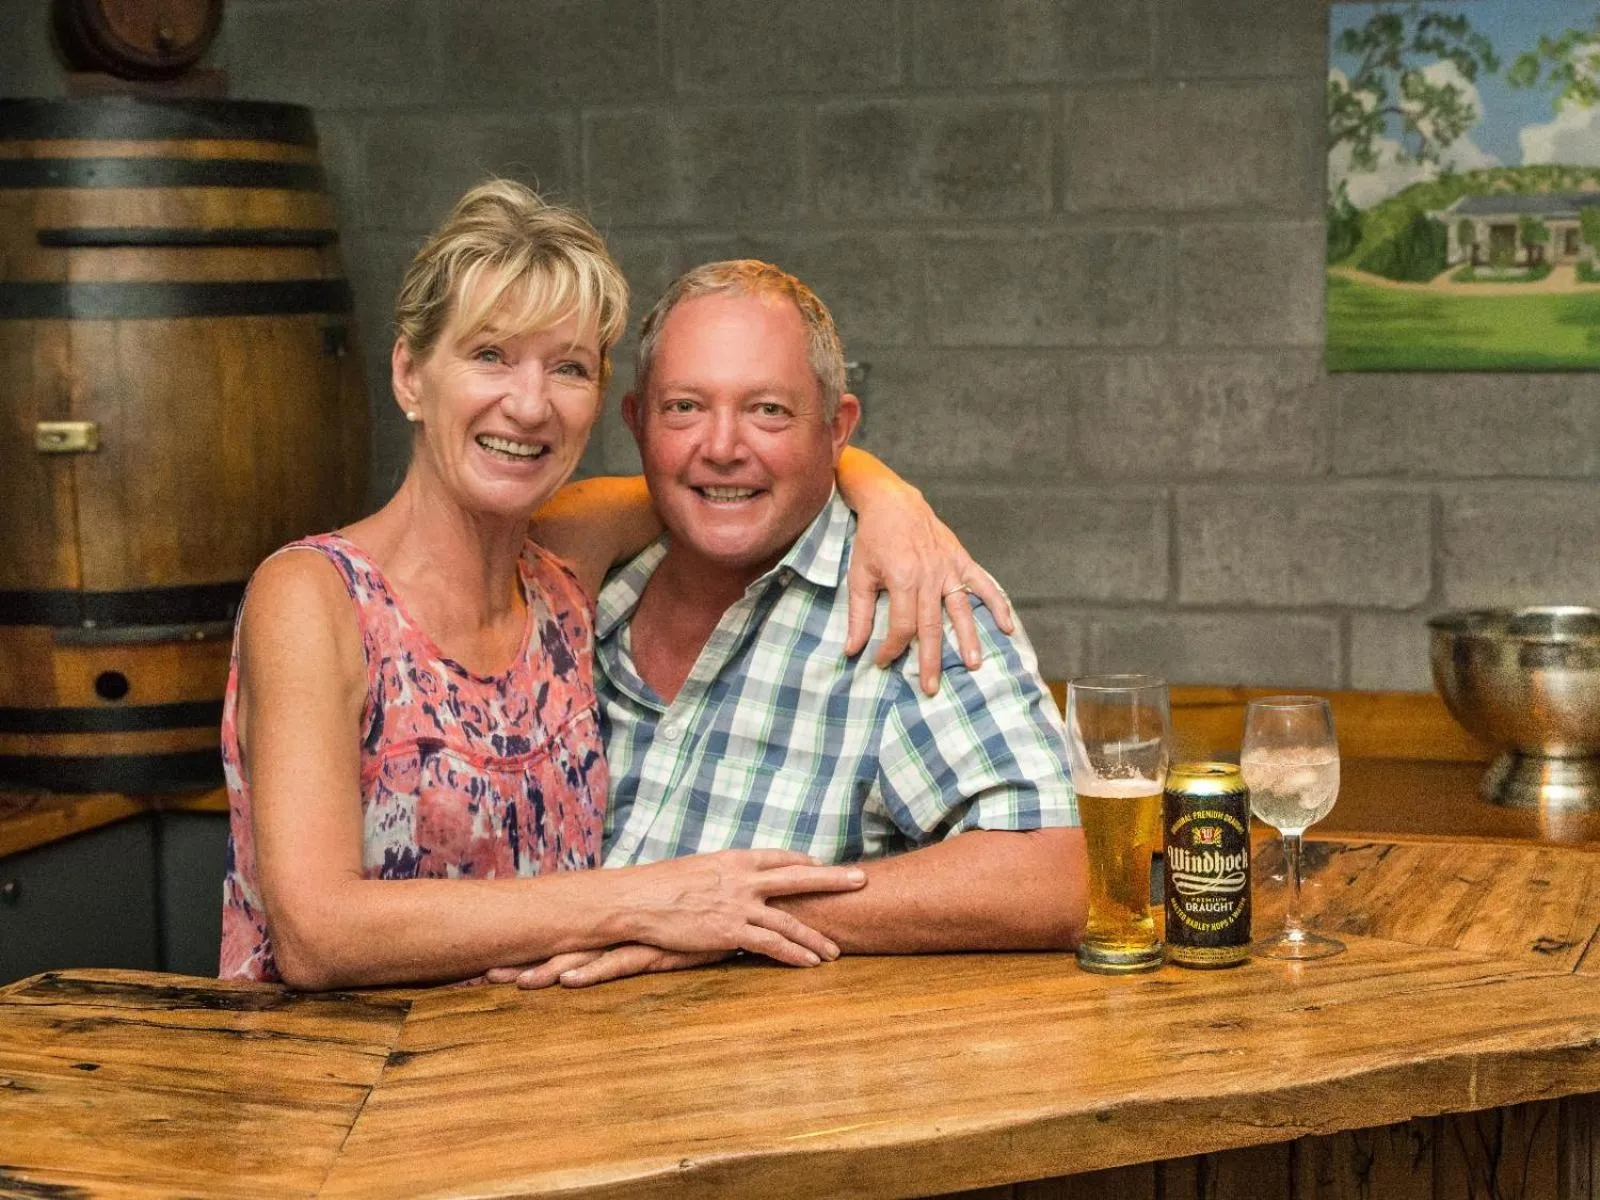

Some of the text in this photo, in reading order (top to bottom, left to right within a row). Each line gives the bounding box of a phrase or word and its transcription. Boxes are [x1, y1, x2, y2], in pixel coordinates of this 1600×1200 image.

[1192, 809, 1224, 819] PREMIUM
[1168, 845, 1248, 876] Windhoek
[1185, 902, 1234, 912] DRAUGHT
[1186, 917, 1210, 932] BARLEY
